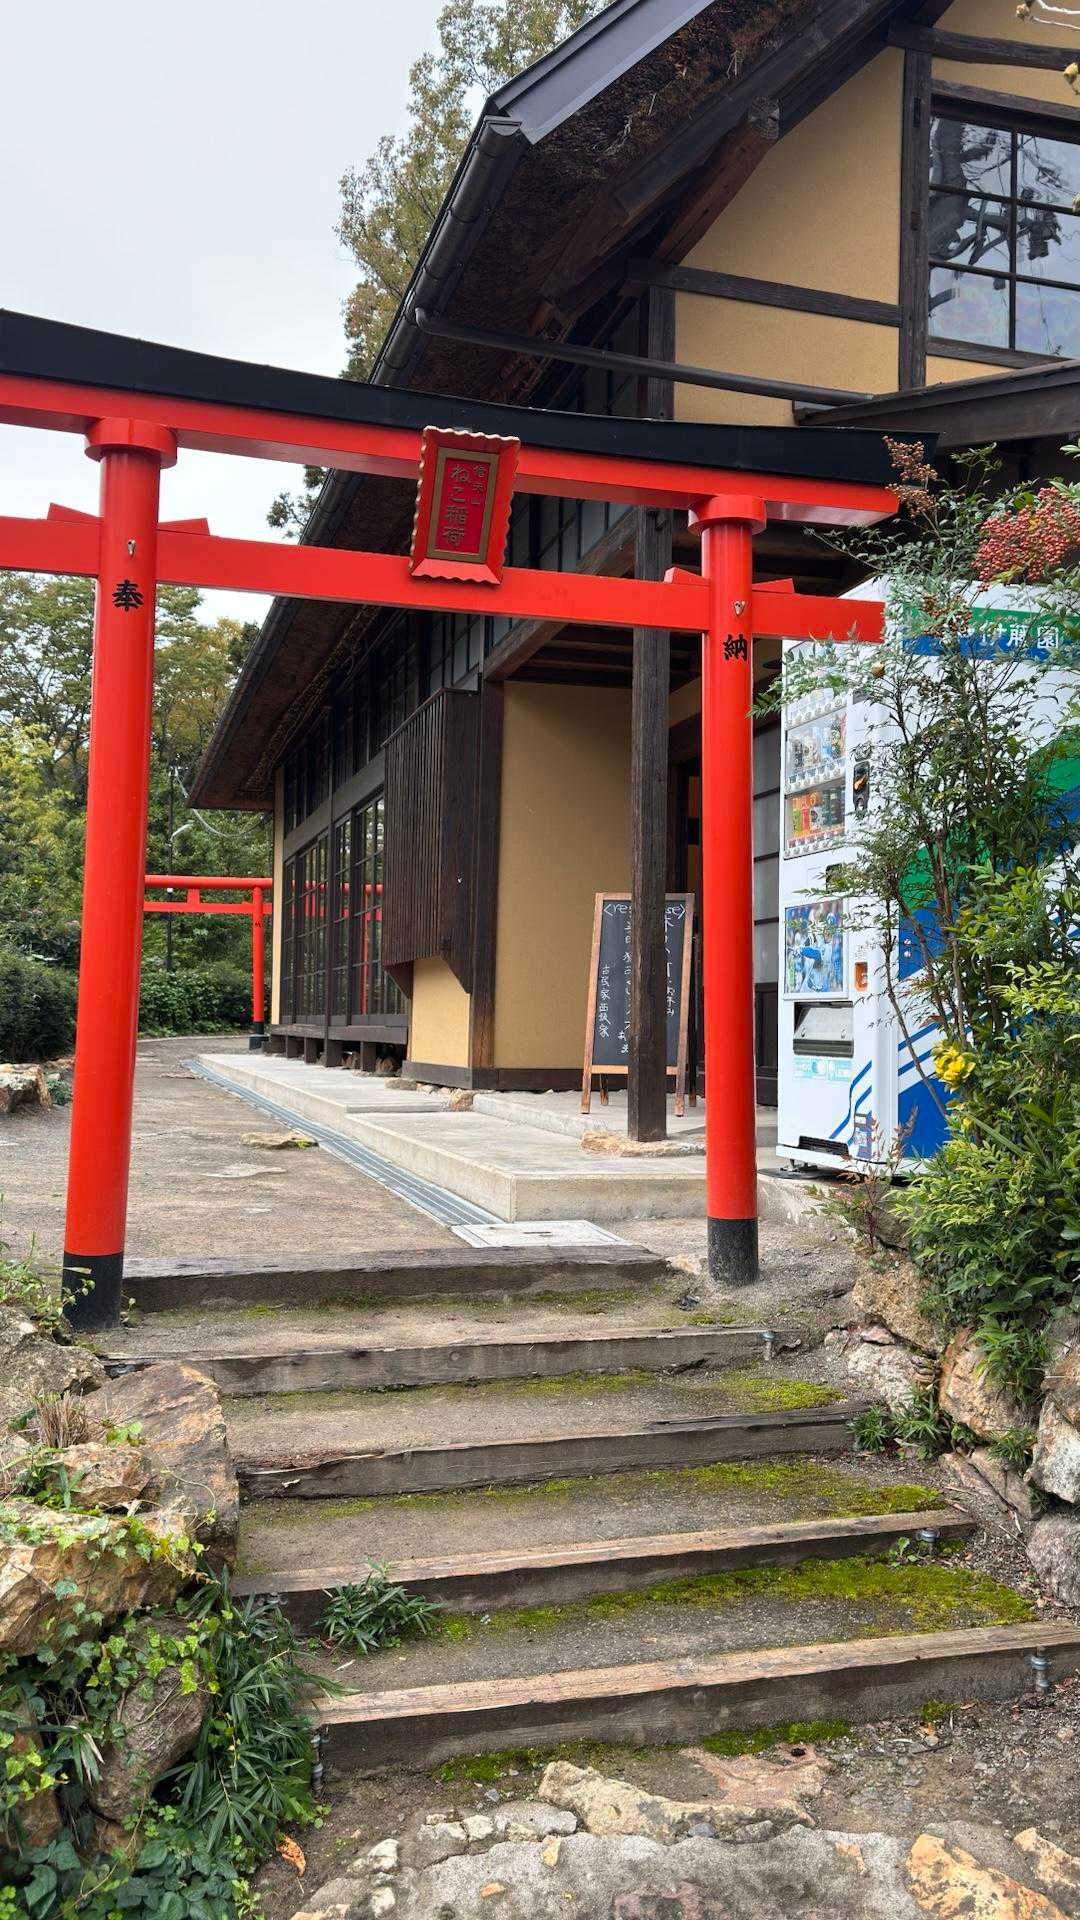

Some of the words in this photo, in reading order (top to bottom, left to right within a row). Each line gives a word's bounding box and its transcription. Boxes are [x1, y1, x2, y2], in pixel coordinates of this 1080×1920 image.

[443, 465, 469, 546] ねこ稲荷
[112, 579, 144, 612] 奉
[722, 633, 748, 661] 納
